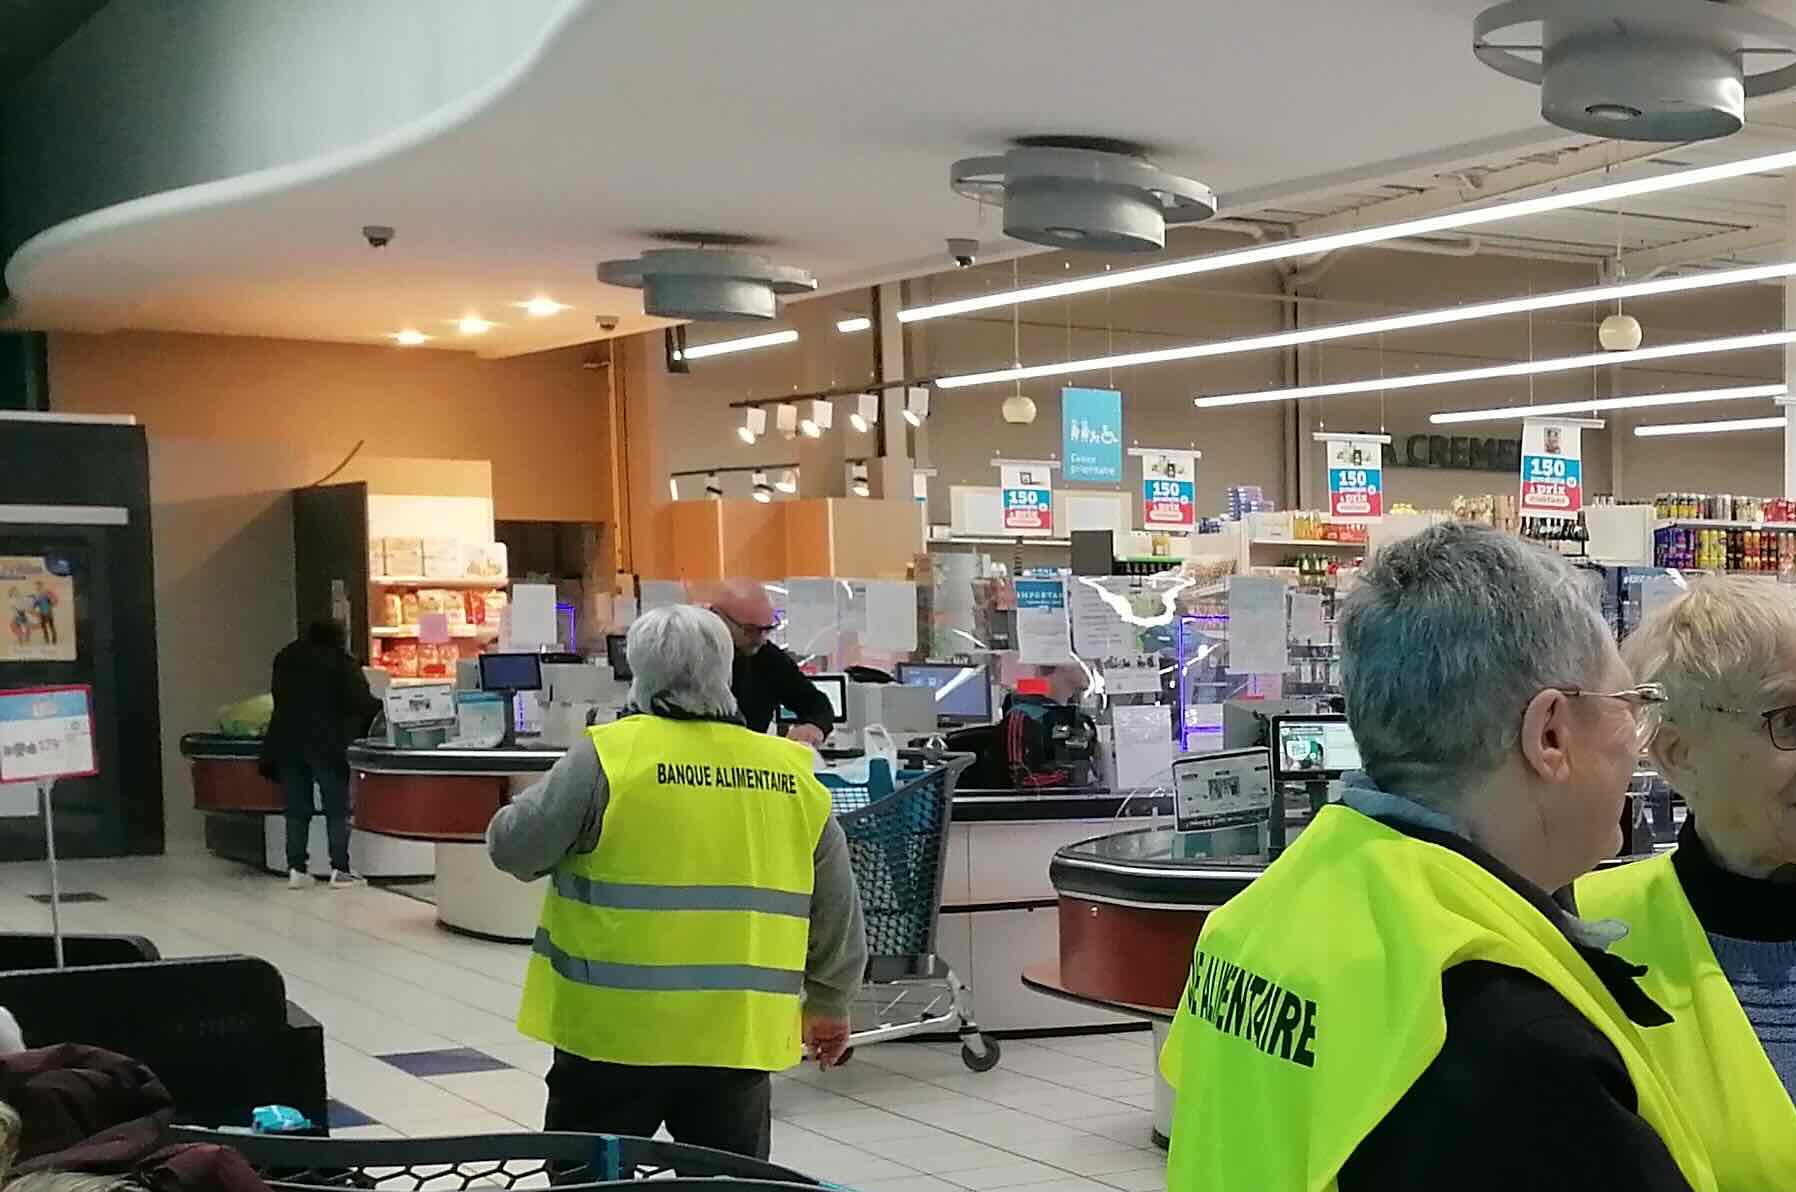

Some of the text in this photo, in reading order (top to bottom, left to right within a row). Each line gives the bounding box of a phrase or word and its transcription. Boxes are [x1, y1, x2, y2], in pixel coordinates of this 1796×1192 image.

[1530, 459, 1567, 477] 150
[1338, 470, 1367, 487] 150
[1007, 490, 1039, 505] 150
[1151, 481, 1180, 497] 150
[656, 763, 797, 794] BANQUE ALIMENTAIRE
